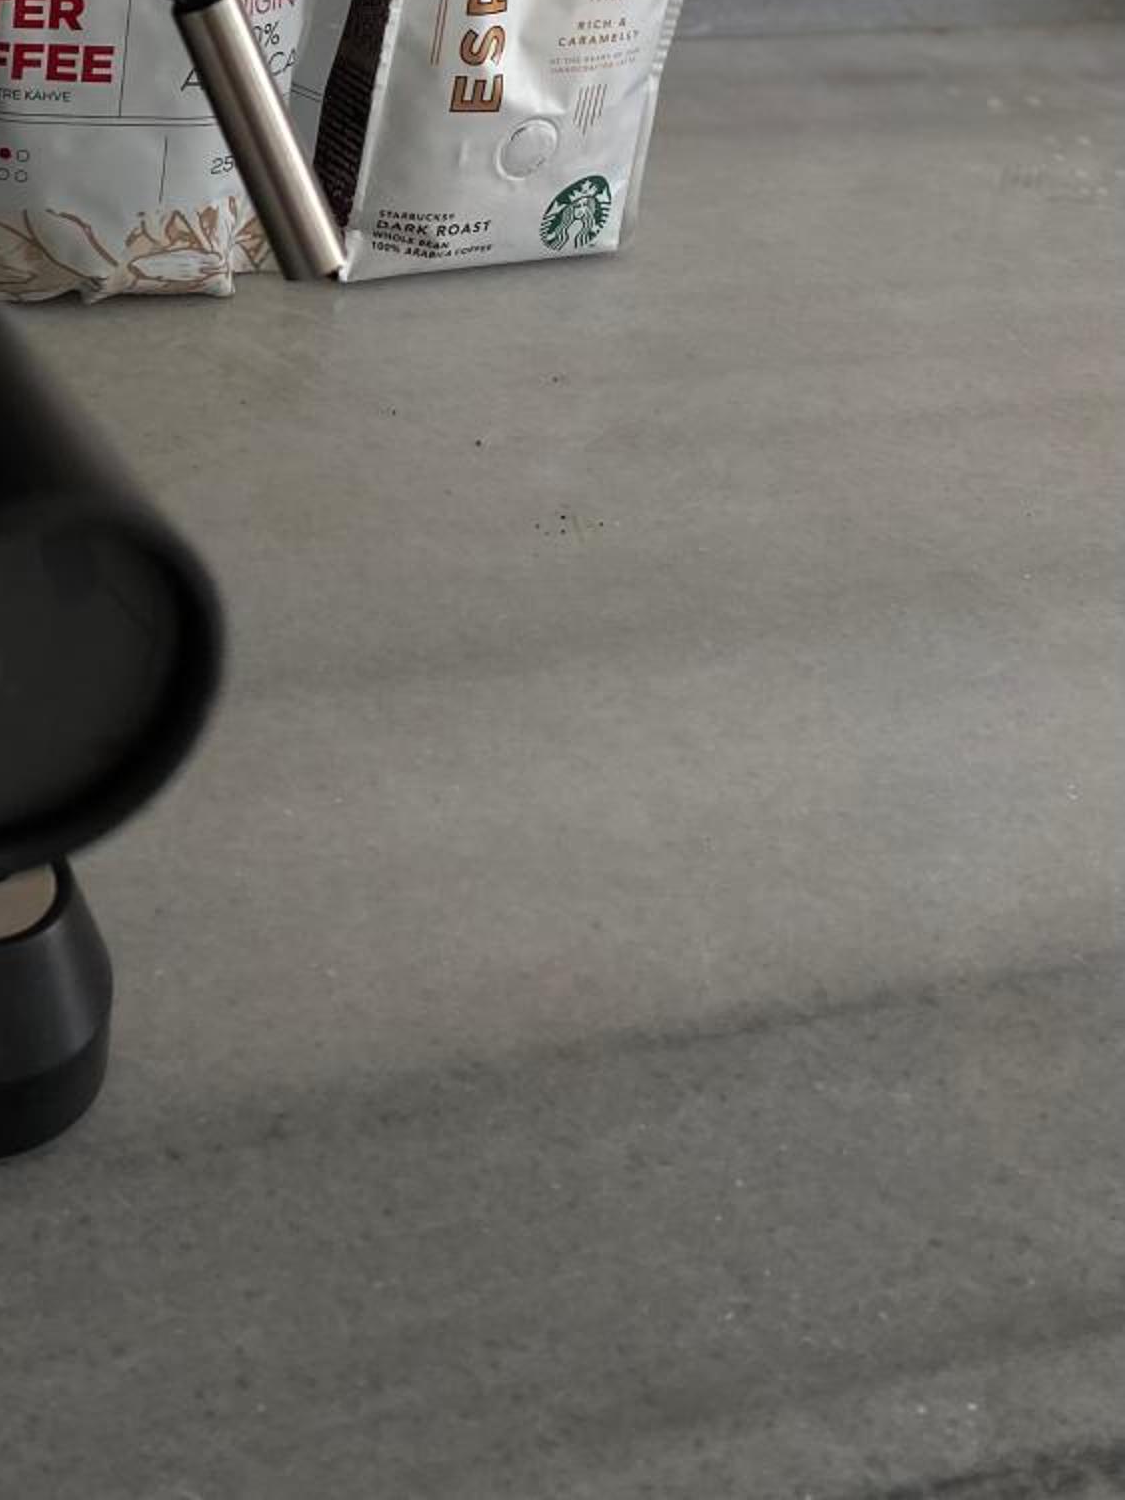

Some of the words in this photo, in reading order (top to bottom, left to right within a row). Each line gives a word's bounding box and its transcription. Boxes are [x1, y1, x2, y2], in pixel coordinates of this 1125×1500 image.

[210, 155, 236, 175] 25
[377, 220, 429, 235] DARK
[436, 219, 492, 237] ROAST
